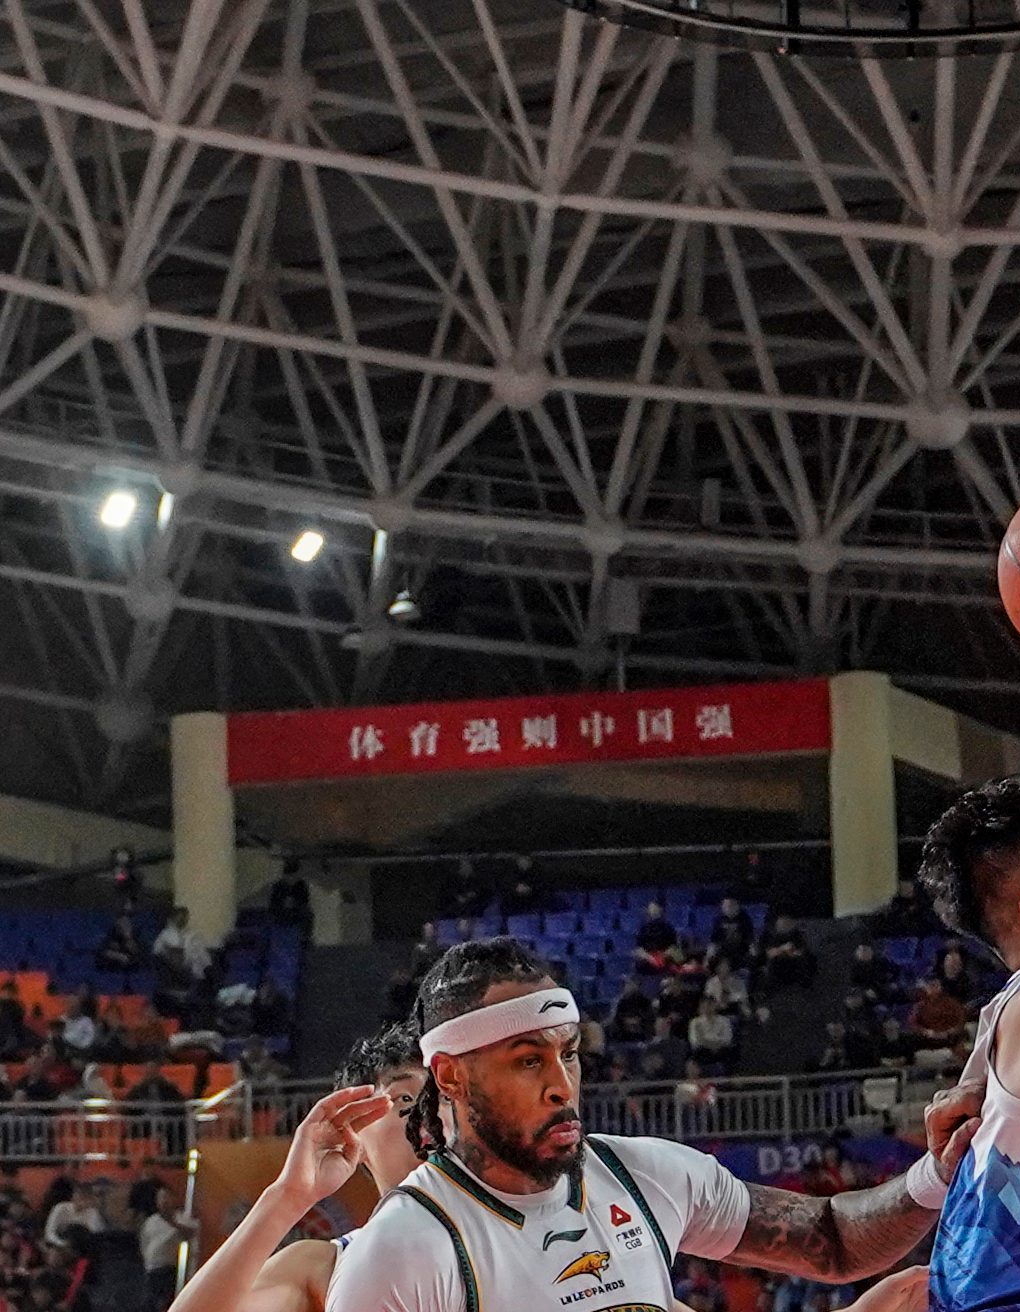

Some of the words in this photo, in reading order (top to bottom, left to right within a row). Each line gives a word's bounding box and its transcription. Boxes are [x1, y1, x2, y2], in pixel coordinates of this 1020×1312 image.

[348, 703, 733, 760] 体育强则中国强
[625, 1237, 642, 1250] CGB
[572, 1279, 626, 1302] LEOPARDS
